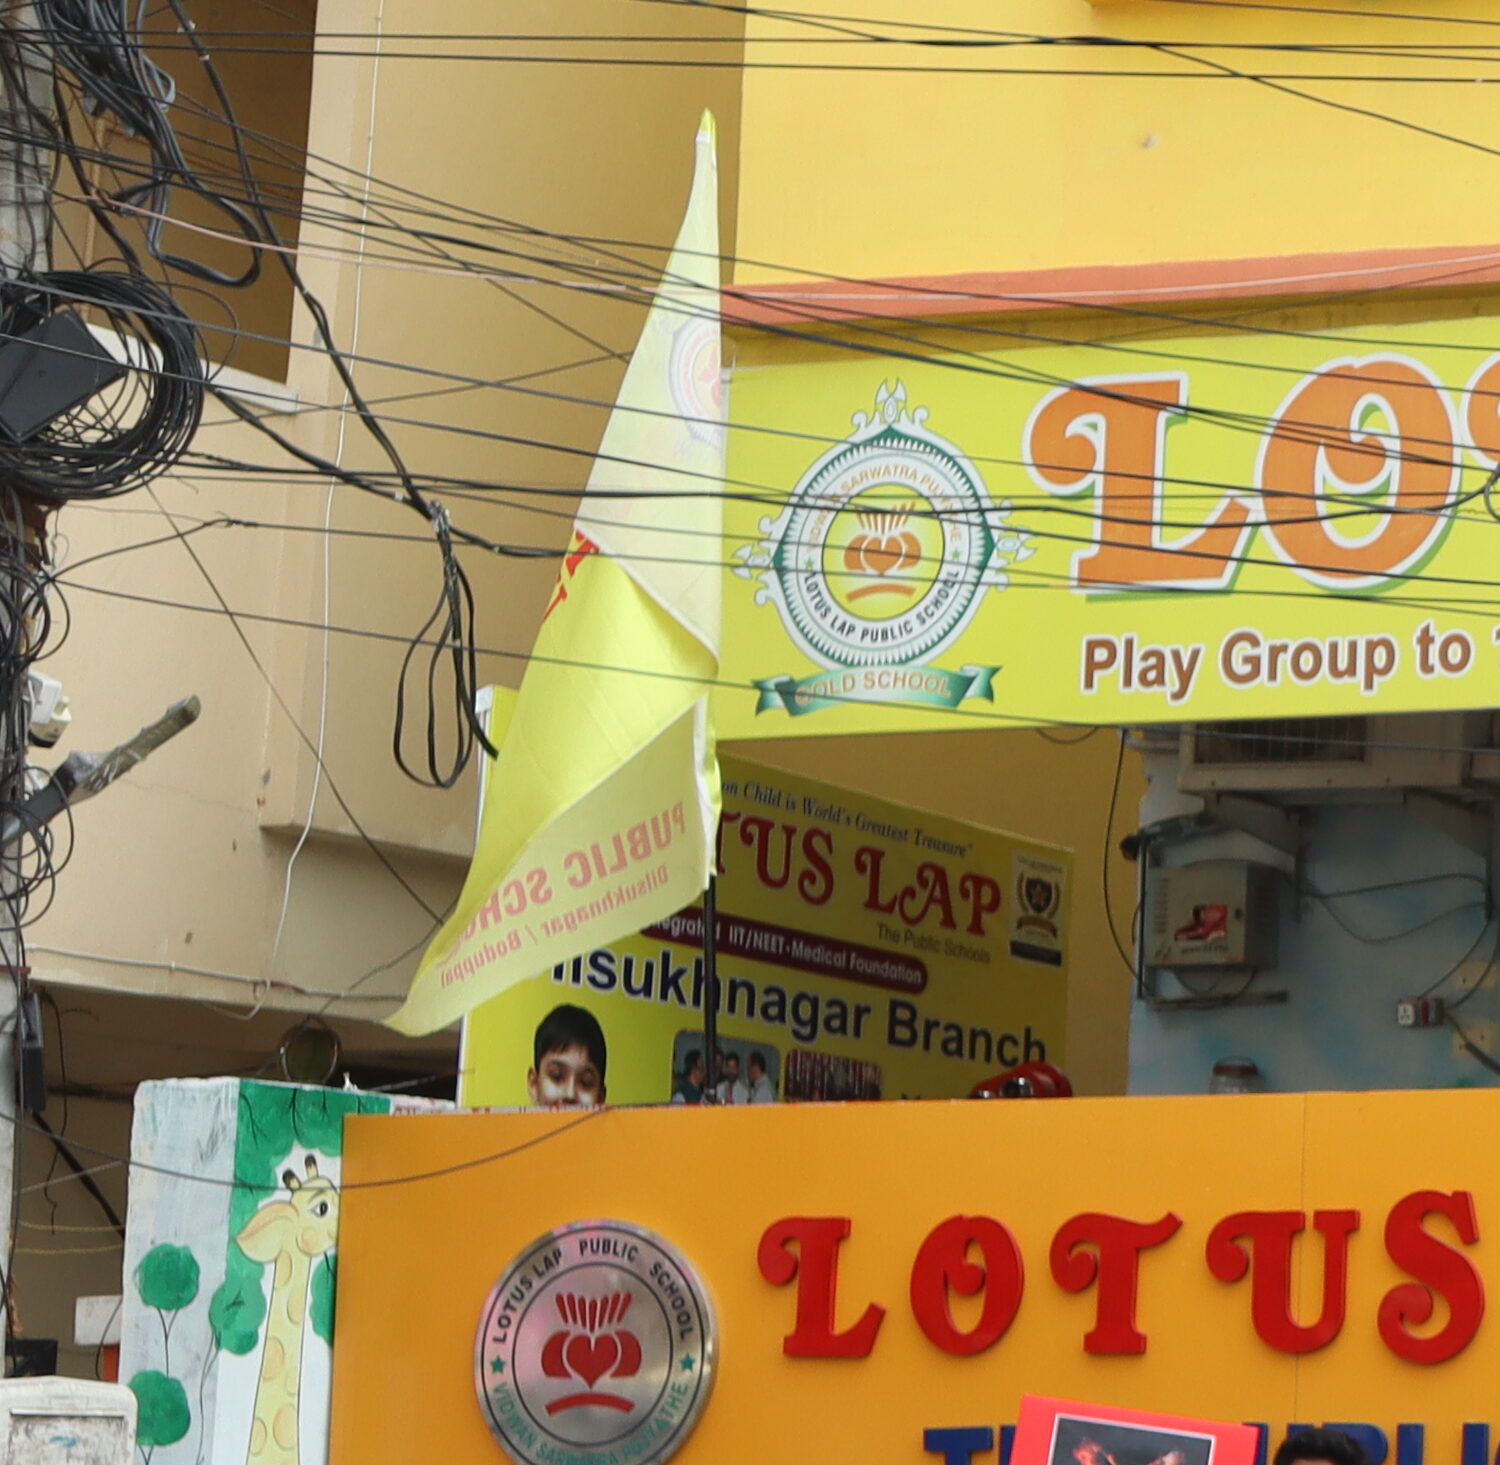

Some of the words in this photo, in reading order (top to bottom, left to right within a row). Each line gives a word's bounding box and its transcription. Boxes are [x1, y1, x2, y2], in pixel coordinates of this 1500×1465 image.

[860, 621, 913, 643] PUBLIC
[1084, 636, 1198, 700] Play
[1222, 624, 1396, 690] Group
[1418, 623, 1471, 675] to
[795, 673, 854, 705] GOLD
[863, 671, 953, 696] SCHOOL
[855, 812, 908, 842] Greatest
[854, 847, 1000, 935] LAP
[944, 938, 990, 963] Schools
[887, 998, 1048, 1070] Branch
[493, 1277, 533, 1344] LOTUS
[579, 1239, 639, 1261] PUBLIC
[650, 1262, 693, 1340] SCHOOL
[759, 1189, 1484, 1365] LOTUS
